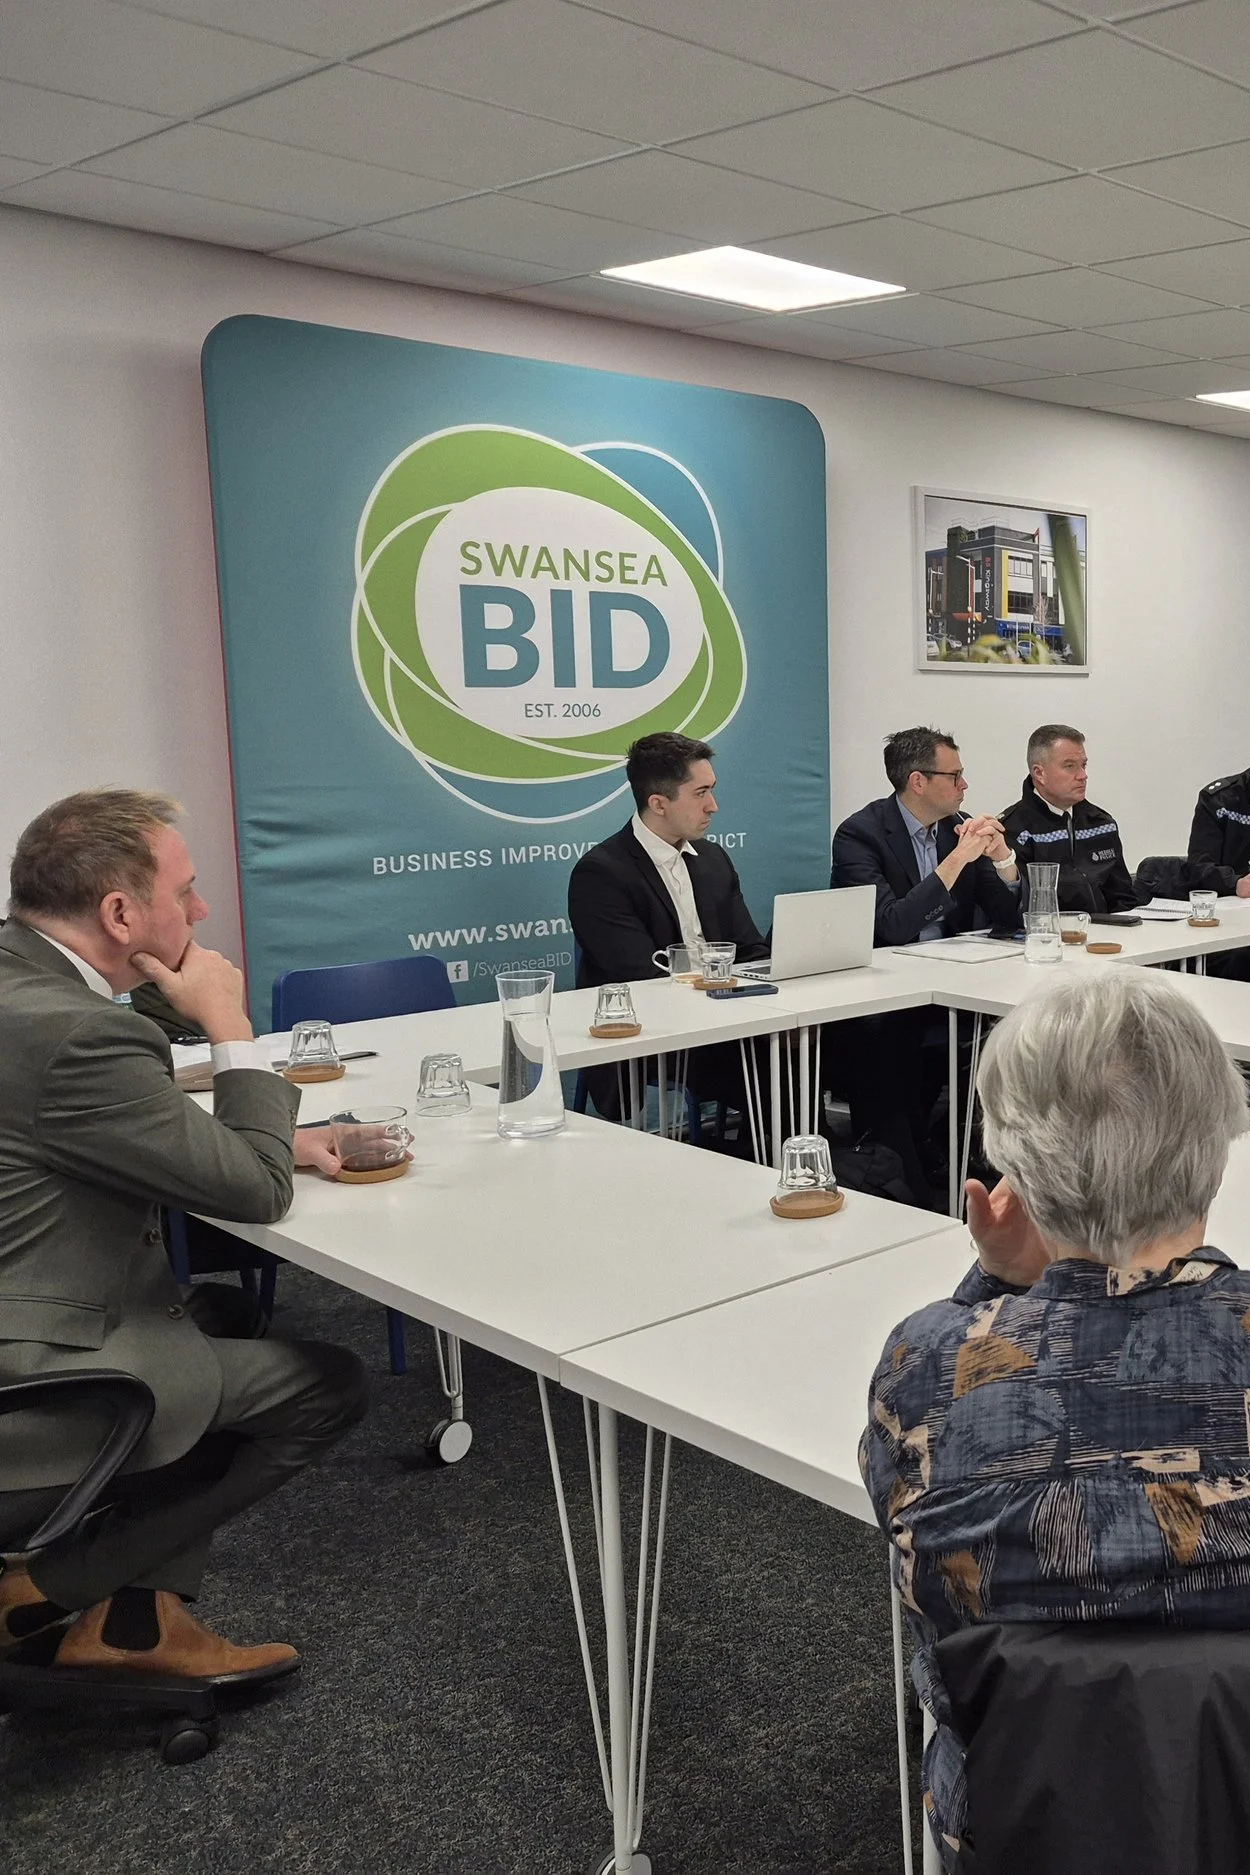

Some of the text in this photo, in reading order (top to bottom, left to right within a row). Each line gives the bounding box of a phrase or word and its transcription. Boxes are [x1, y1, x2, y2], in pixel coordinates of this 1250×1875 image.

[459, 540, 668, 587] SWANSEA
[459, 584, 671, 689] BID
[524, 703, 601, 718] EST. 2006
[372, 849, 493, 875] BUSINESS
[408, 917, 573, 950] www.swan
[473, 951, 572, 977] /SwanseaBID
